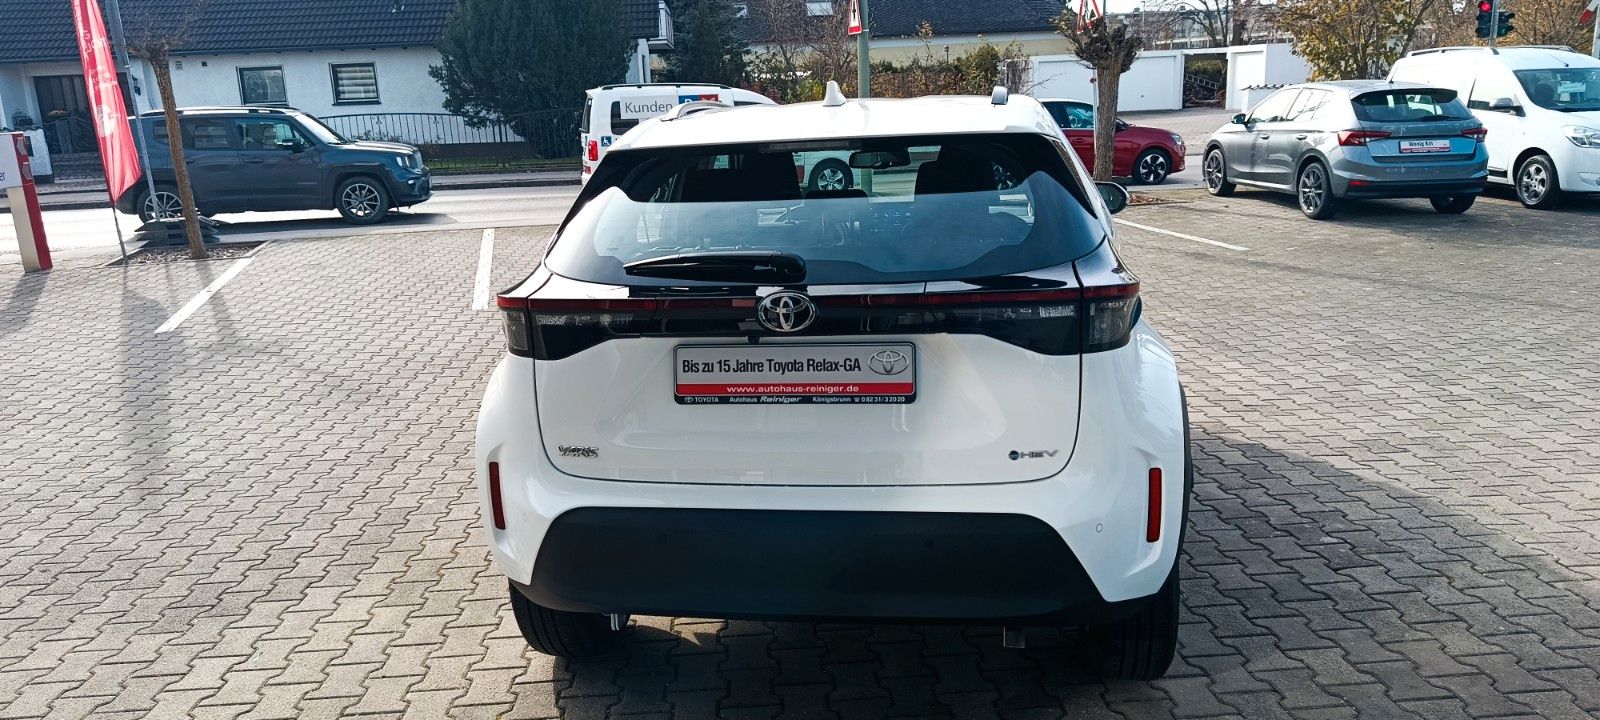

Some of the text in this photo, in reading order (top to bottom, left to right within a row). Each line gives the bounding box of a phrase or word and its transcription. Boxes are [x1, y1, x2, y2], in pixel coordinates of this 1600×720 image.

[625, 101, 673, 114] Kunden
[682, 358, 861, 376] Bis zu 15 Jahre Toyota Relax-GA
[726, 384, 859, 394] www.autohaus-reiniger.de
[760, 395, 802, 404] Reiniger
[1020, 449, 1058, 459] HEV
